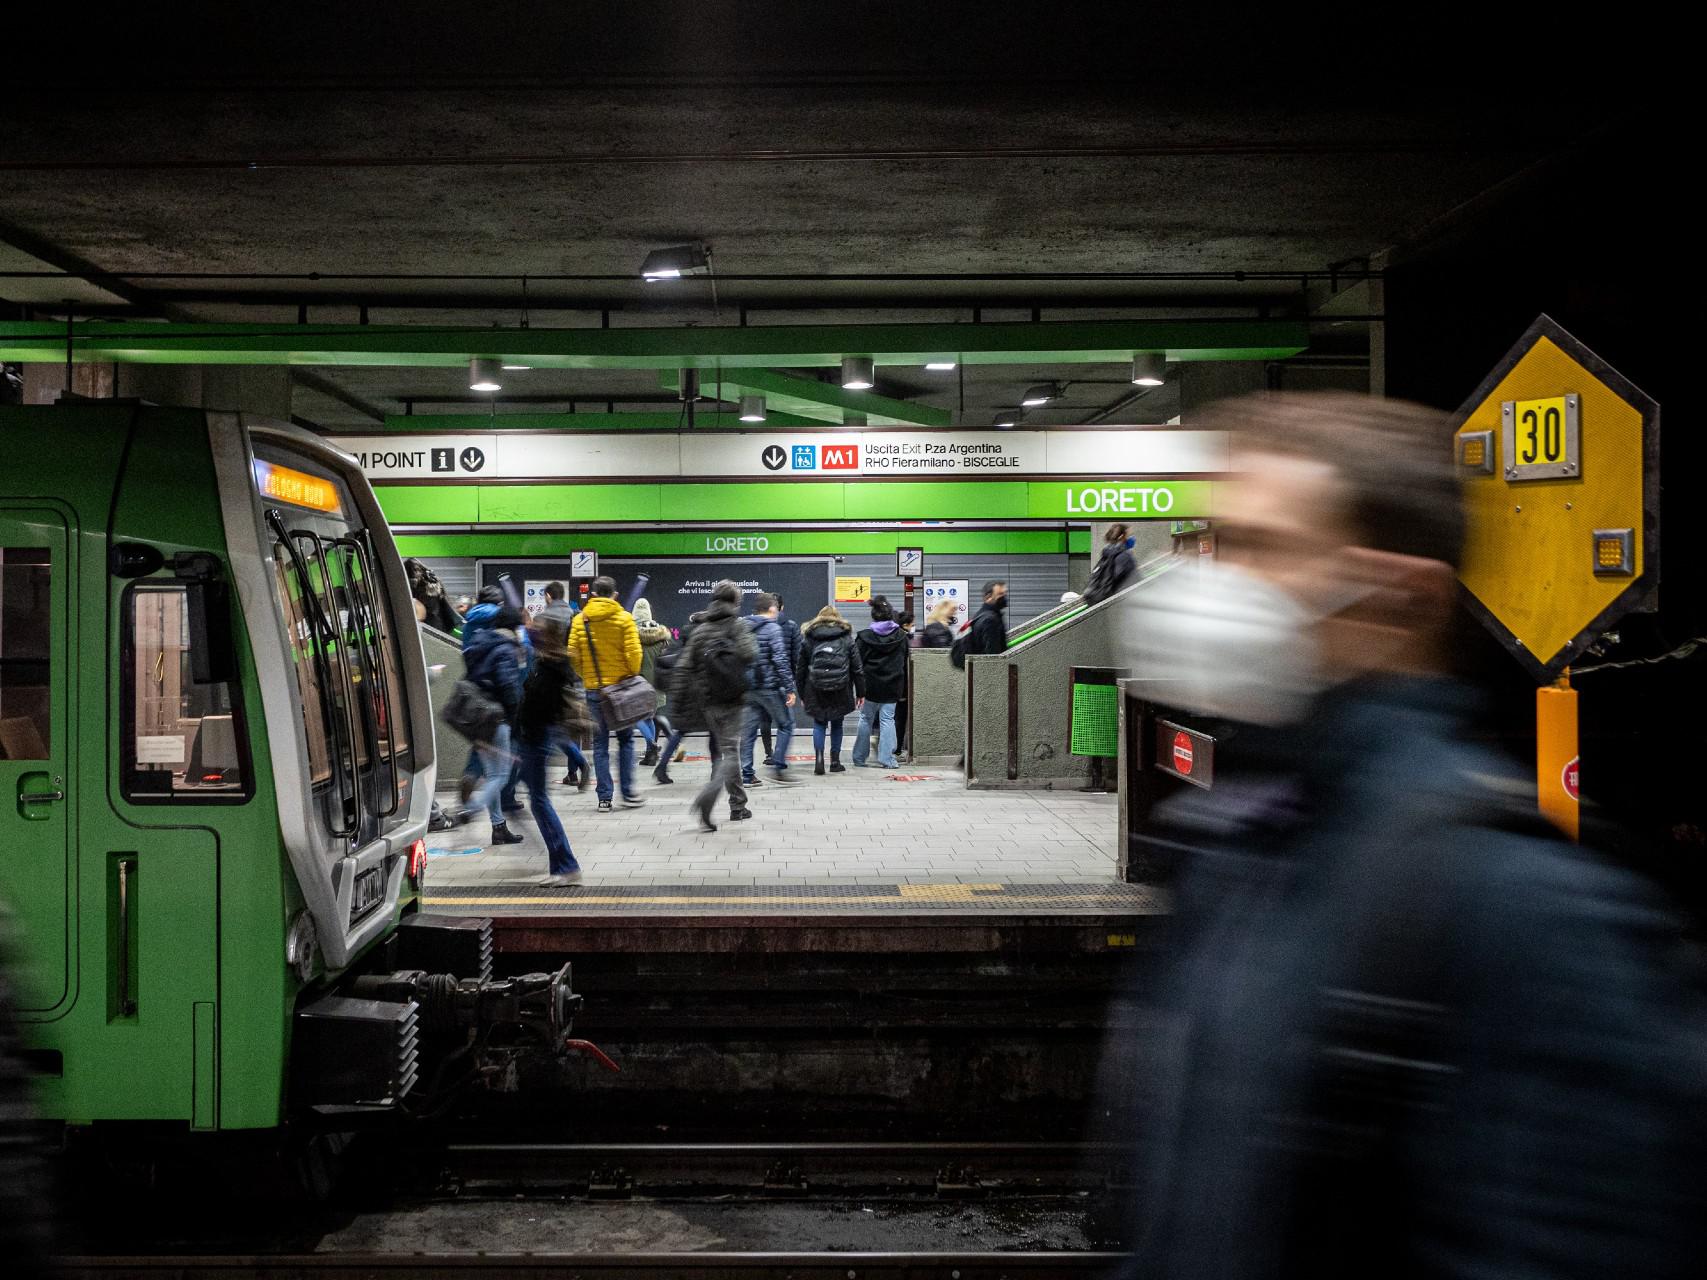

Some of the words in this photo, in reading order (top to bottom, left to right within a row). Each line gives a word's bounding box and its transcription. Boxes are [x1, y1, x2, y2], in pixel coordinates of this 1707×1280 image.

[1523, 407, 1560, 463] 30
[865, 444, 900, 454] Uscita
[902, 444, 921, 454] Exit
[948, 444, 1002, 456] Argentina
[372, 452, 426, 469] POINT
[865, 457, 890, 468] RHO
[963, 456, 1020, 468] BISCEGLIE
[1066, 488, 1174, 513] LORETO
[706, 537, 769, 552] LORETO
